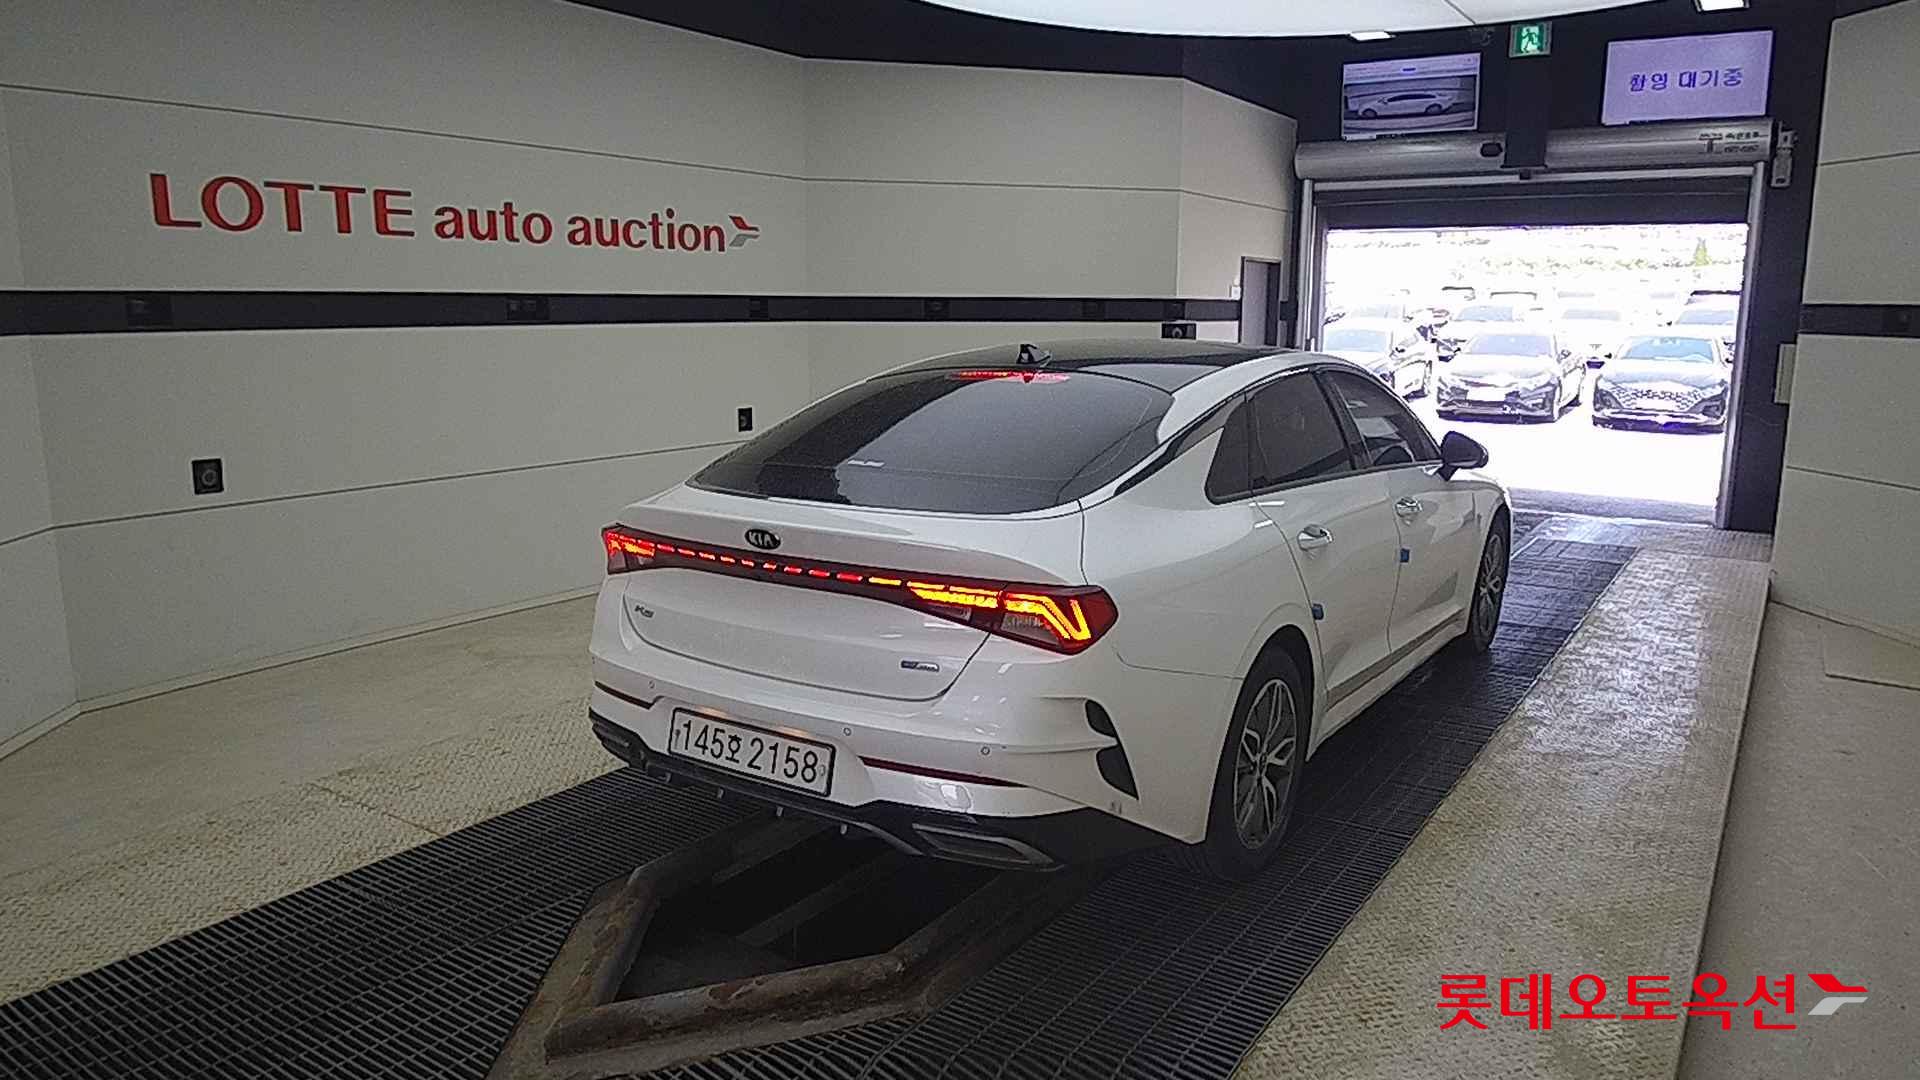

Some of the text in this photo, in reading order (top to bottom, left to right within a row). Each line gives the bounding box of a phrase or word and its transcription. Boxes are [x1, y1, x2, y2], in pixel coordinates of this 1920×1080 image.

[1679, 67, 1743, 88] 대기중
[149, 173, 726, 252] LOTTE auto auction
[748, 530, 774, 547] KIA
[683, 720, 818, 783] 145호 2158
